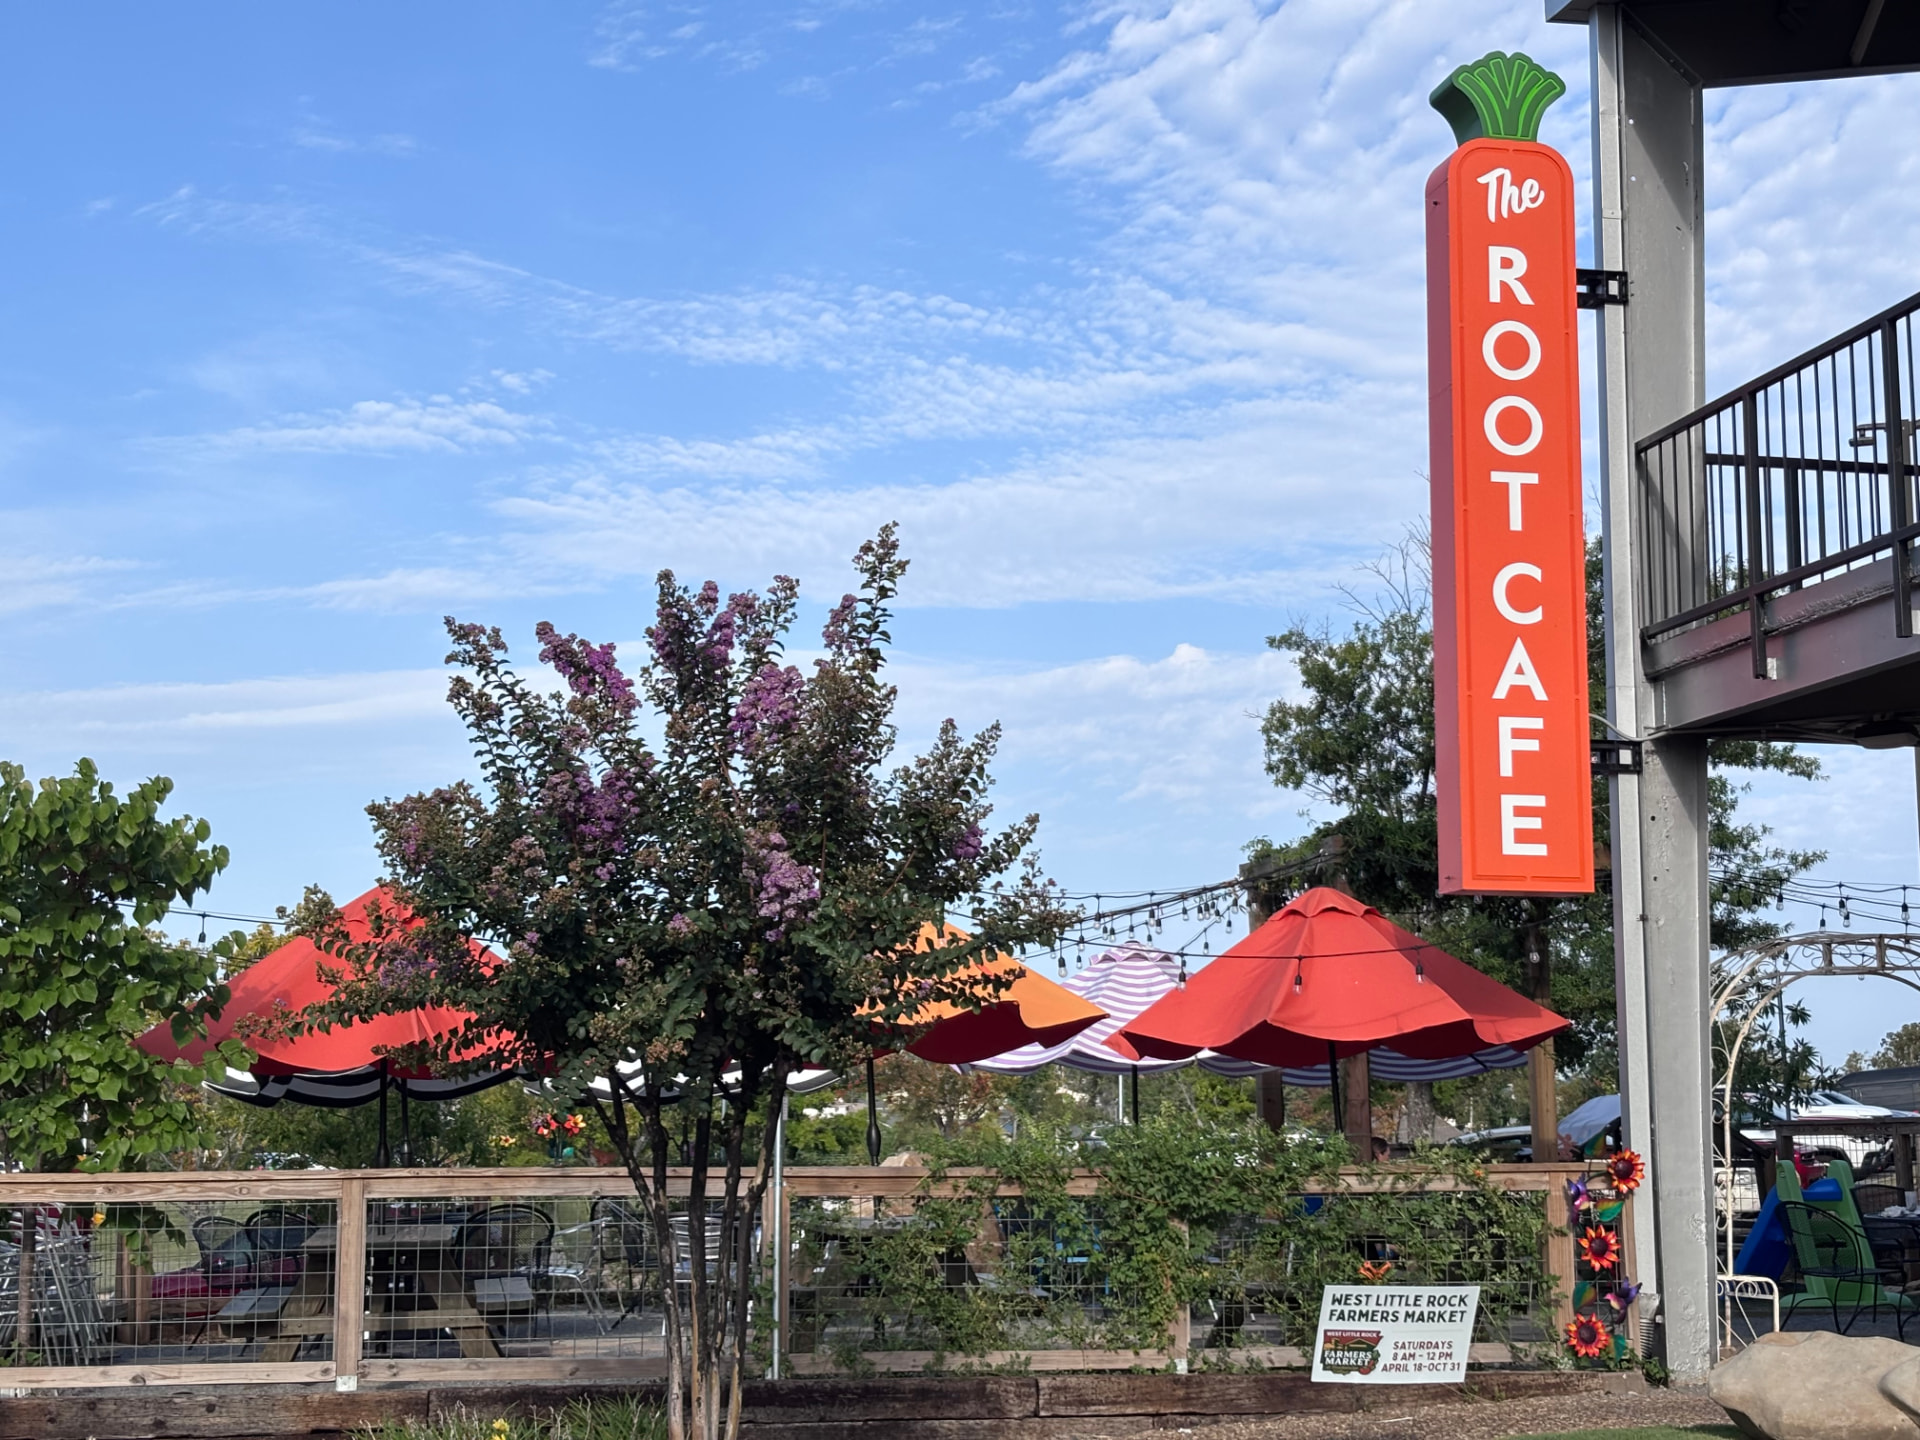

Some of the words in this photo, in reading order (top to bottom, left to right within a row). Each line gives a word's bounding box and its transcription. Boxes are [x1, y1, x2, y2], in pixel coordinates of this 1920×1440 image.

[1476, 167, 1545, 223] The
[1482, 245, 1543, 531] ROOT
[1492, 562, 1548, 856] CAFE
[1331, 1293, 1372, 1306] WEST
[1375, 1294, 1423, 1307] LITTLE
[1426, 1294, 1469, 1308] ROCK
[1328, 1309, 1400, 1323] FARMERS
[1403, 1310, 1467, 1323] MARKET
[1392, 1340, 1453, 1350] SATURDAYS
[1324, 1350, 1372, 1359] FARMERS
[1392, 1352, 1398, 1361] 8
[1400, 1352, 1416, 1361] AM
[1426, 1351, 1436, 1360] 12
[1438, 1351, 1453, 1360] PM
[1325, 1358, 1370, 1366] MARKET
[1381, 1363, 1409, 1373] APRIL
[1449, 1362, 1460, 1371] 31
